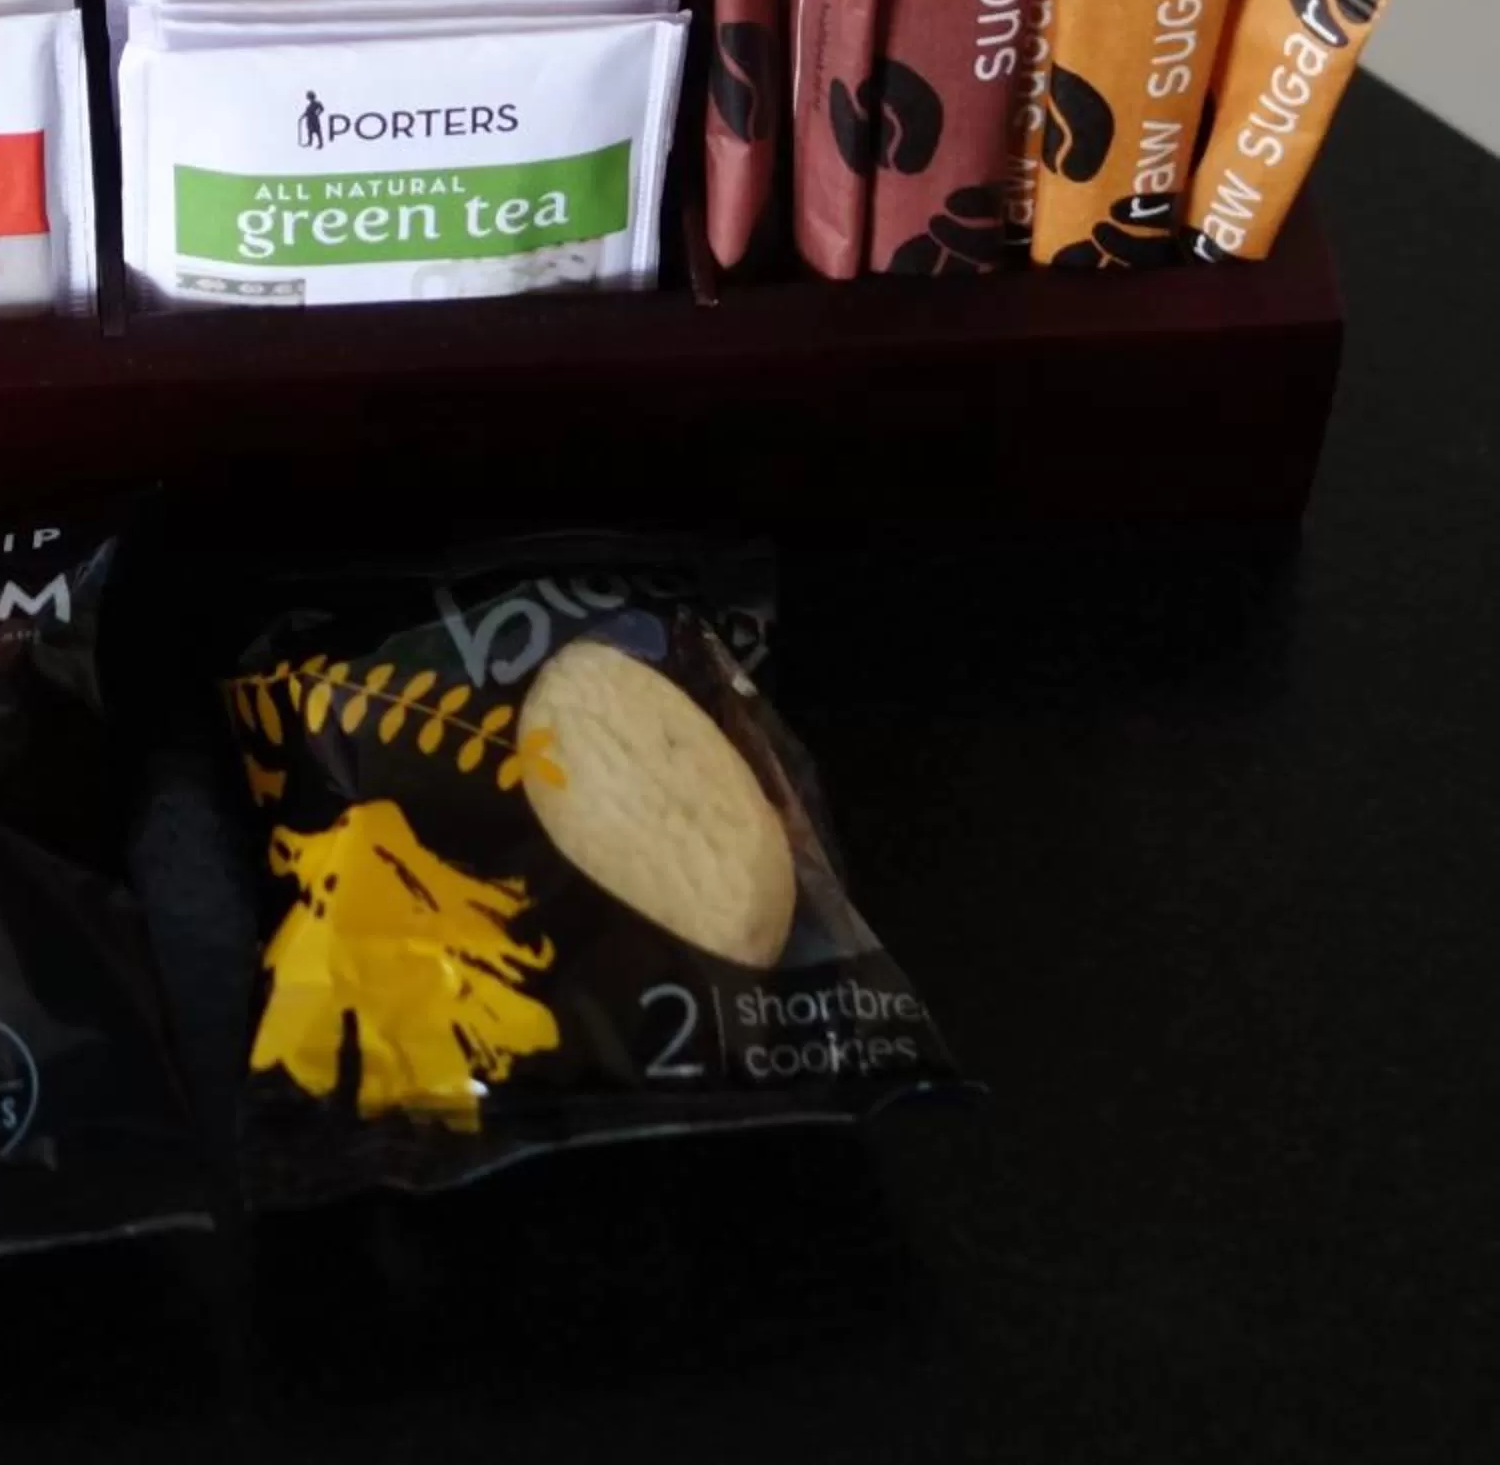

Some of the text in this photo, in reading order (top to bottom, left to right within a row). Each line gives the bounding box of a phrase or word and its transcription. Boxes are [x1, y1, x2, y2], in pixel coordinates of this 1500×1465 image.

[328, 103, 519, 141] PORTERS
[254, 175, 467, 202] ALL NATURAL
[1129, 120, 1183, 219] raw
[236, 189, 570, 258] green tea
[1193, 169, 1263, 263] raw
[638, 983, 704, 1078] 2
[734, 978, 930, 1027] shortbre
